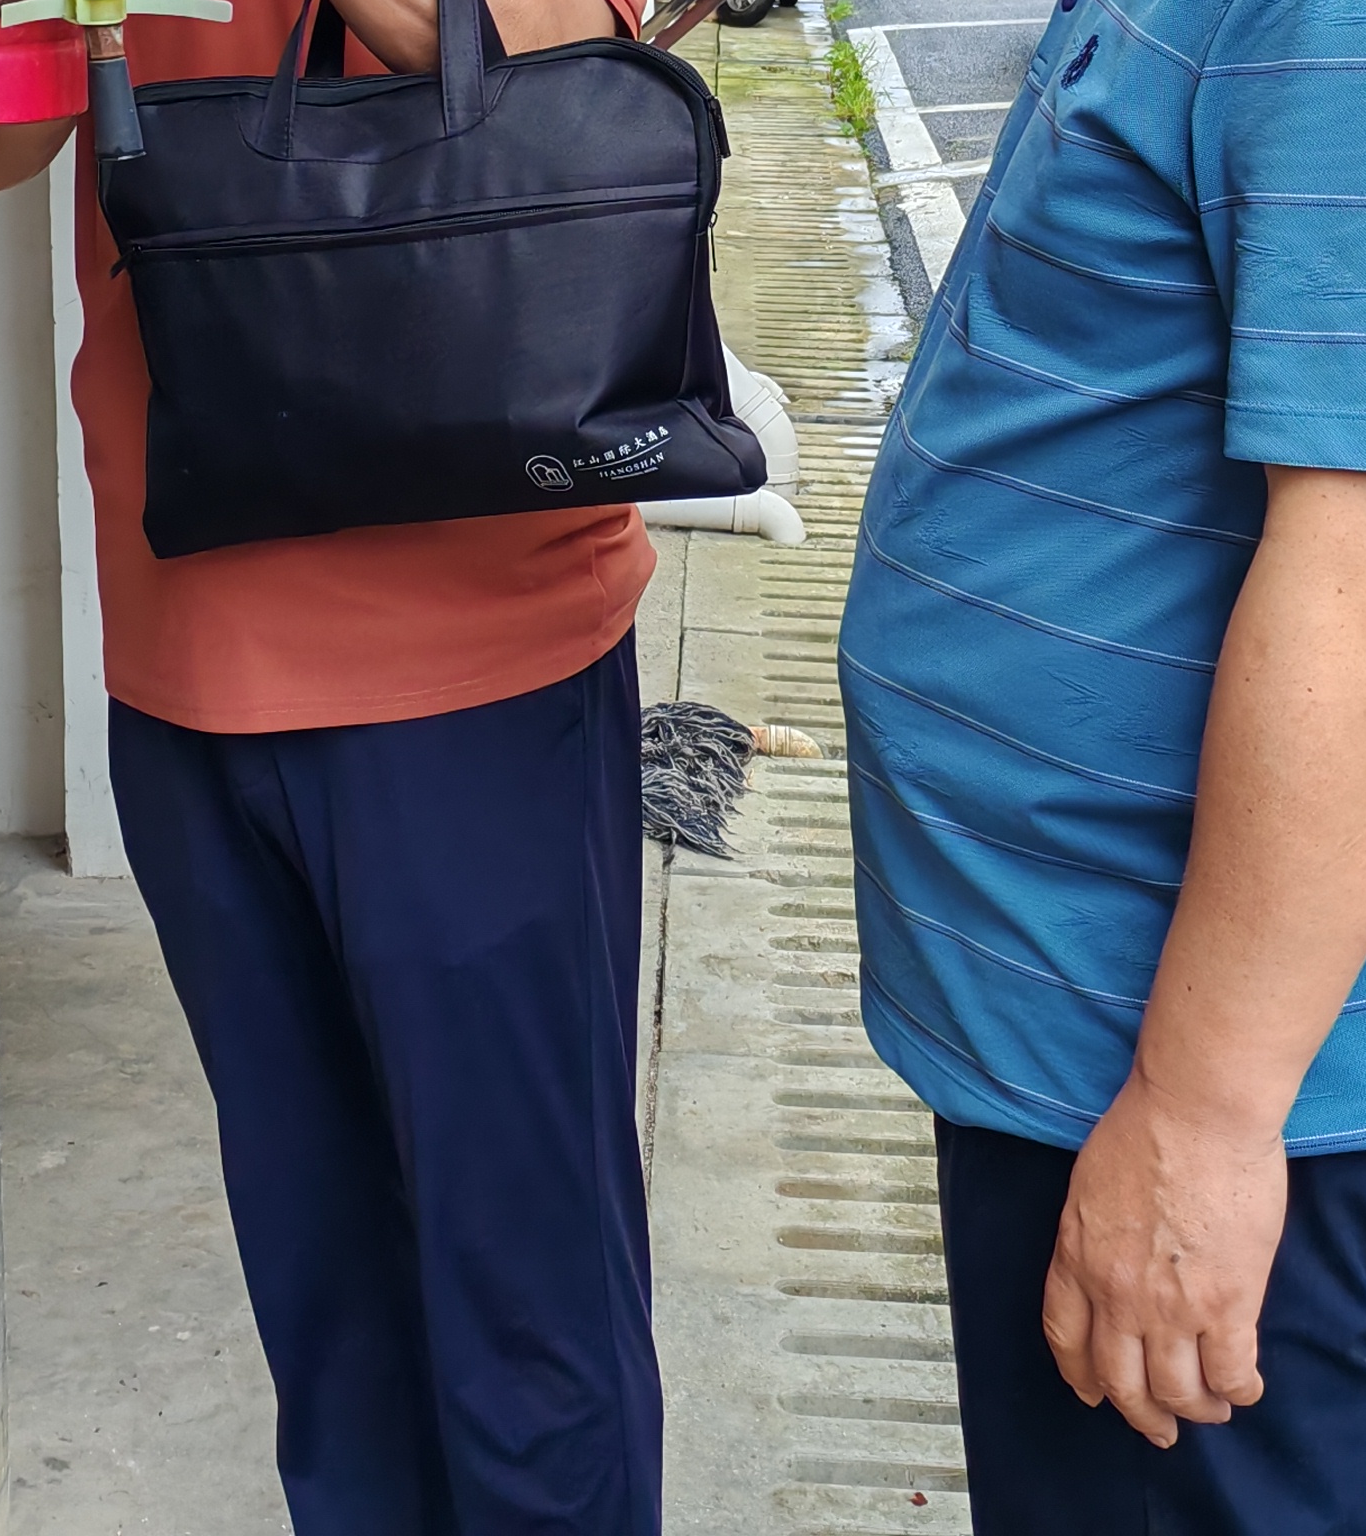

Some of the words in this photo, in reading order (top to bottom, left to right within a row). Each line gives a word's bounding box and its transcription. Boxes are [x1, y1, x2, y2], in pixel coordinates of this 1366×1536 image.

[572, 425, 669, 468] 江山国际大酒店
